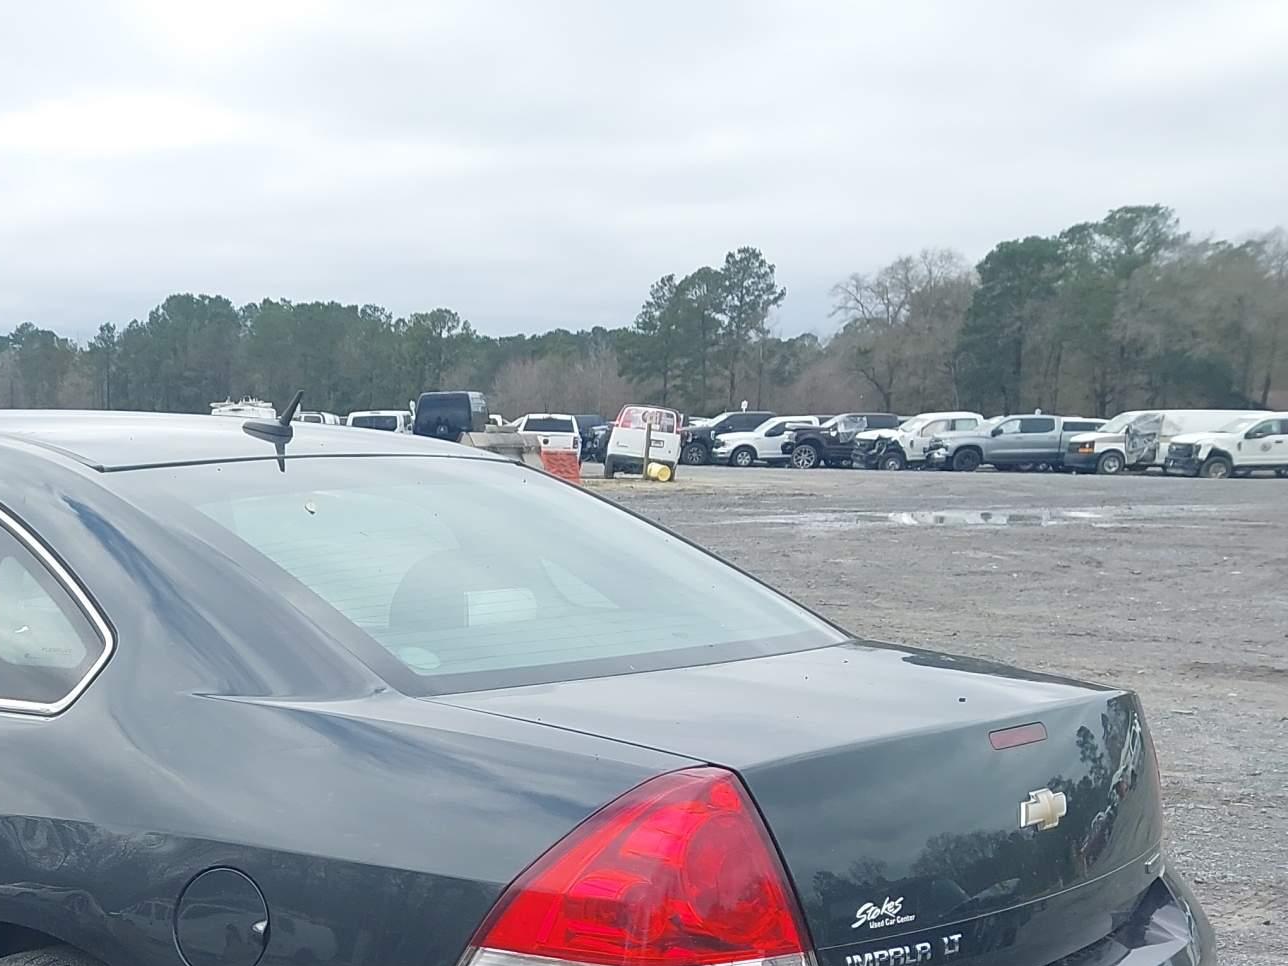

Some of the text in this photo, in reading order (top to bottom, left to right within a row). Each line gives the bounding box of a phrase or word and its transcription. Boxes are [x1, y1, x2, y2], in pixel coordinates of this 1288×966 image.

[851, 897, 904, 928] Stokes
[870, 914, 916, 929] Used Car Center
[942, 933, 962, 956] LT
